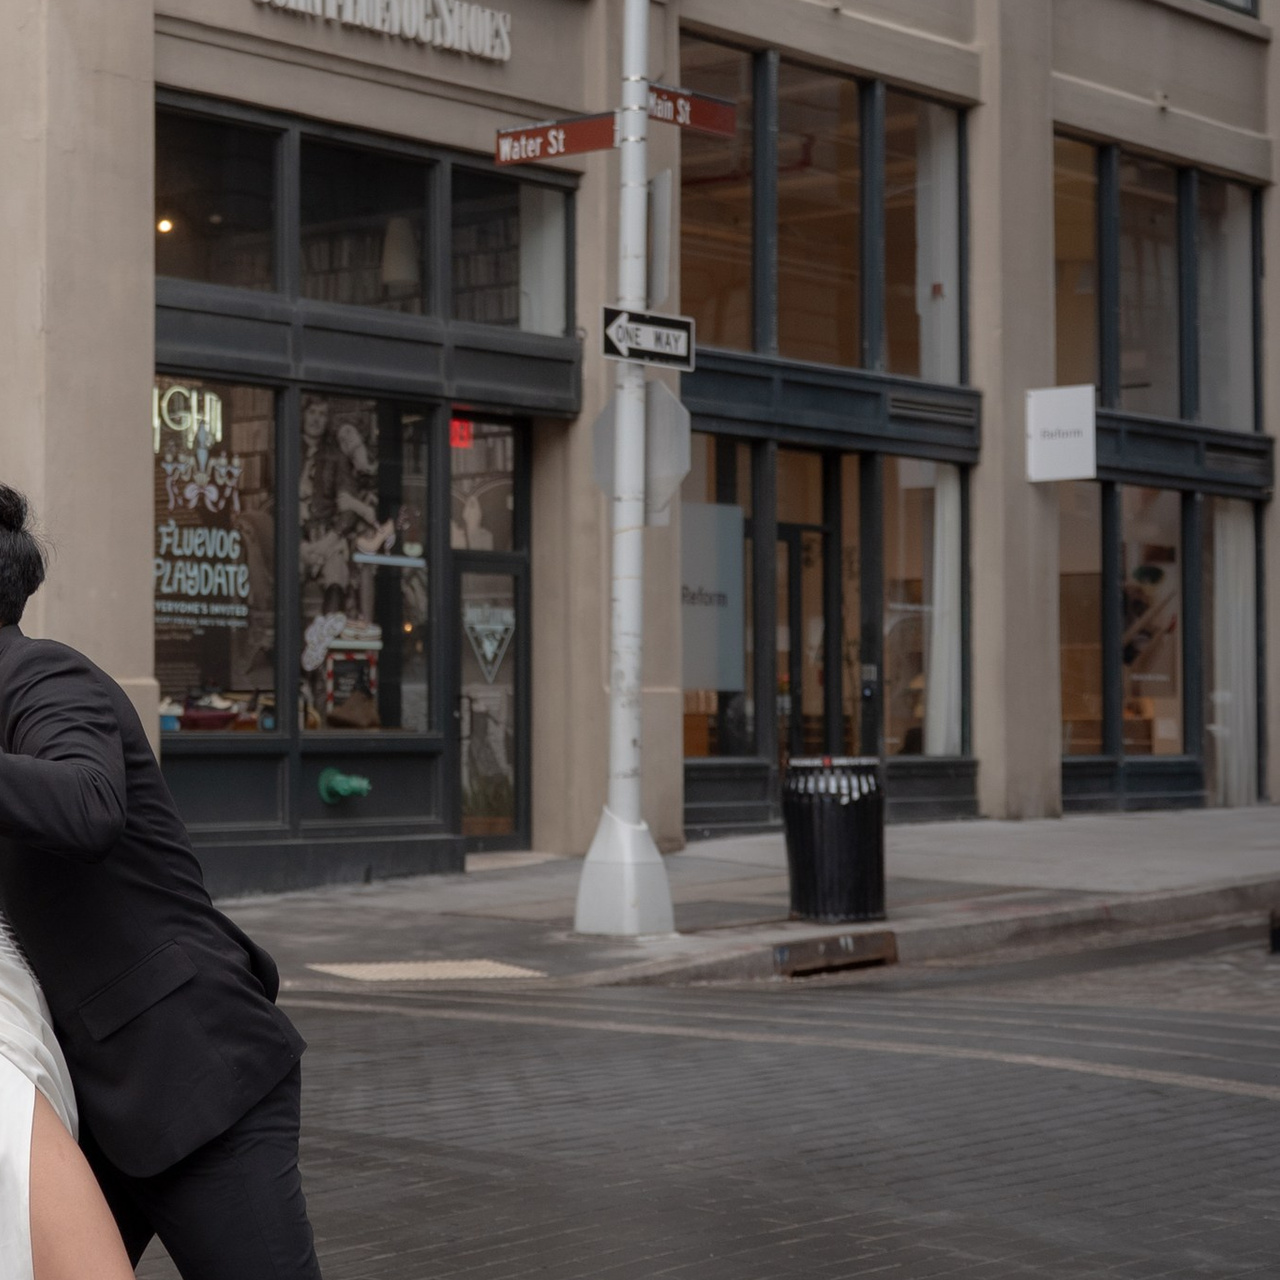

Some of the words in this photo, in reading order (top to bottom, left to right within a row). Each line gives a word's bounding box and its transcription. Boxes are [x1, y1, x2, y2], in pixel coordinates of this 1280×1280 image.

[676, 97, 691, 125] St
[499, 132, 543, 161] Water
[547, 128, 566, 154] St
[616, 325, 641, 346] ONE
[653, 330, 682, 352] WAY
[155, 600, 208, 615] VERYONE'S
